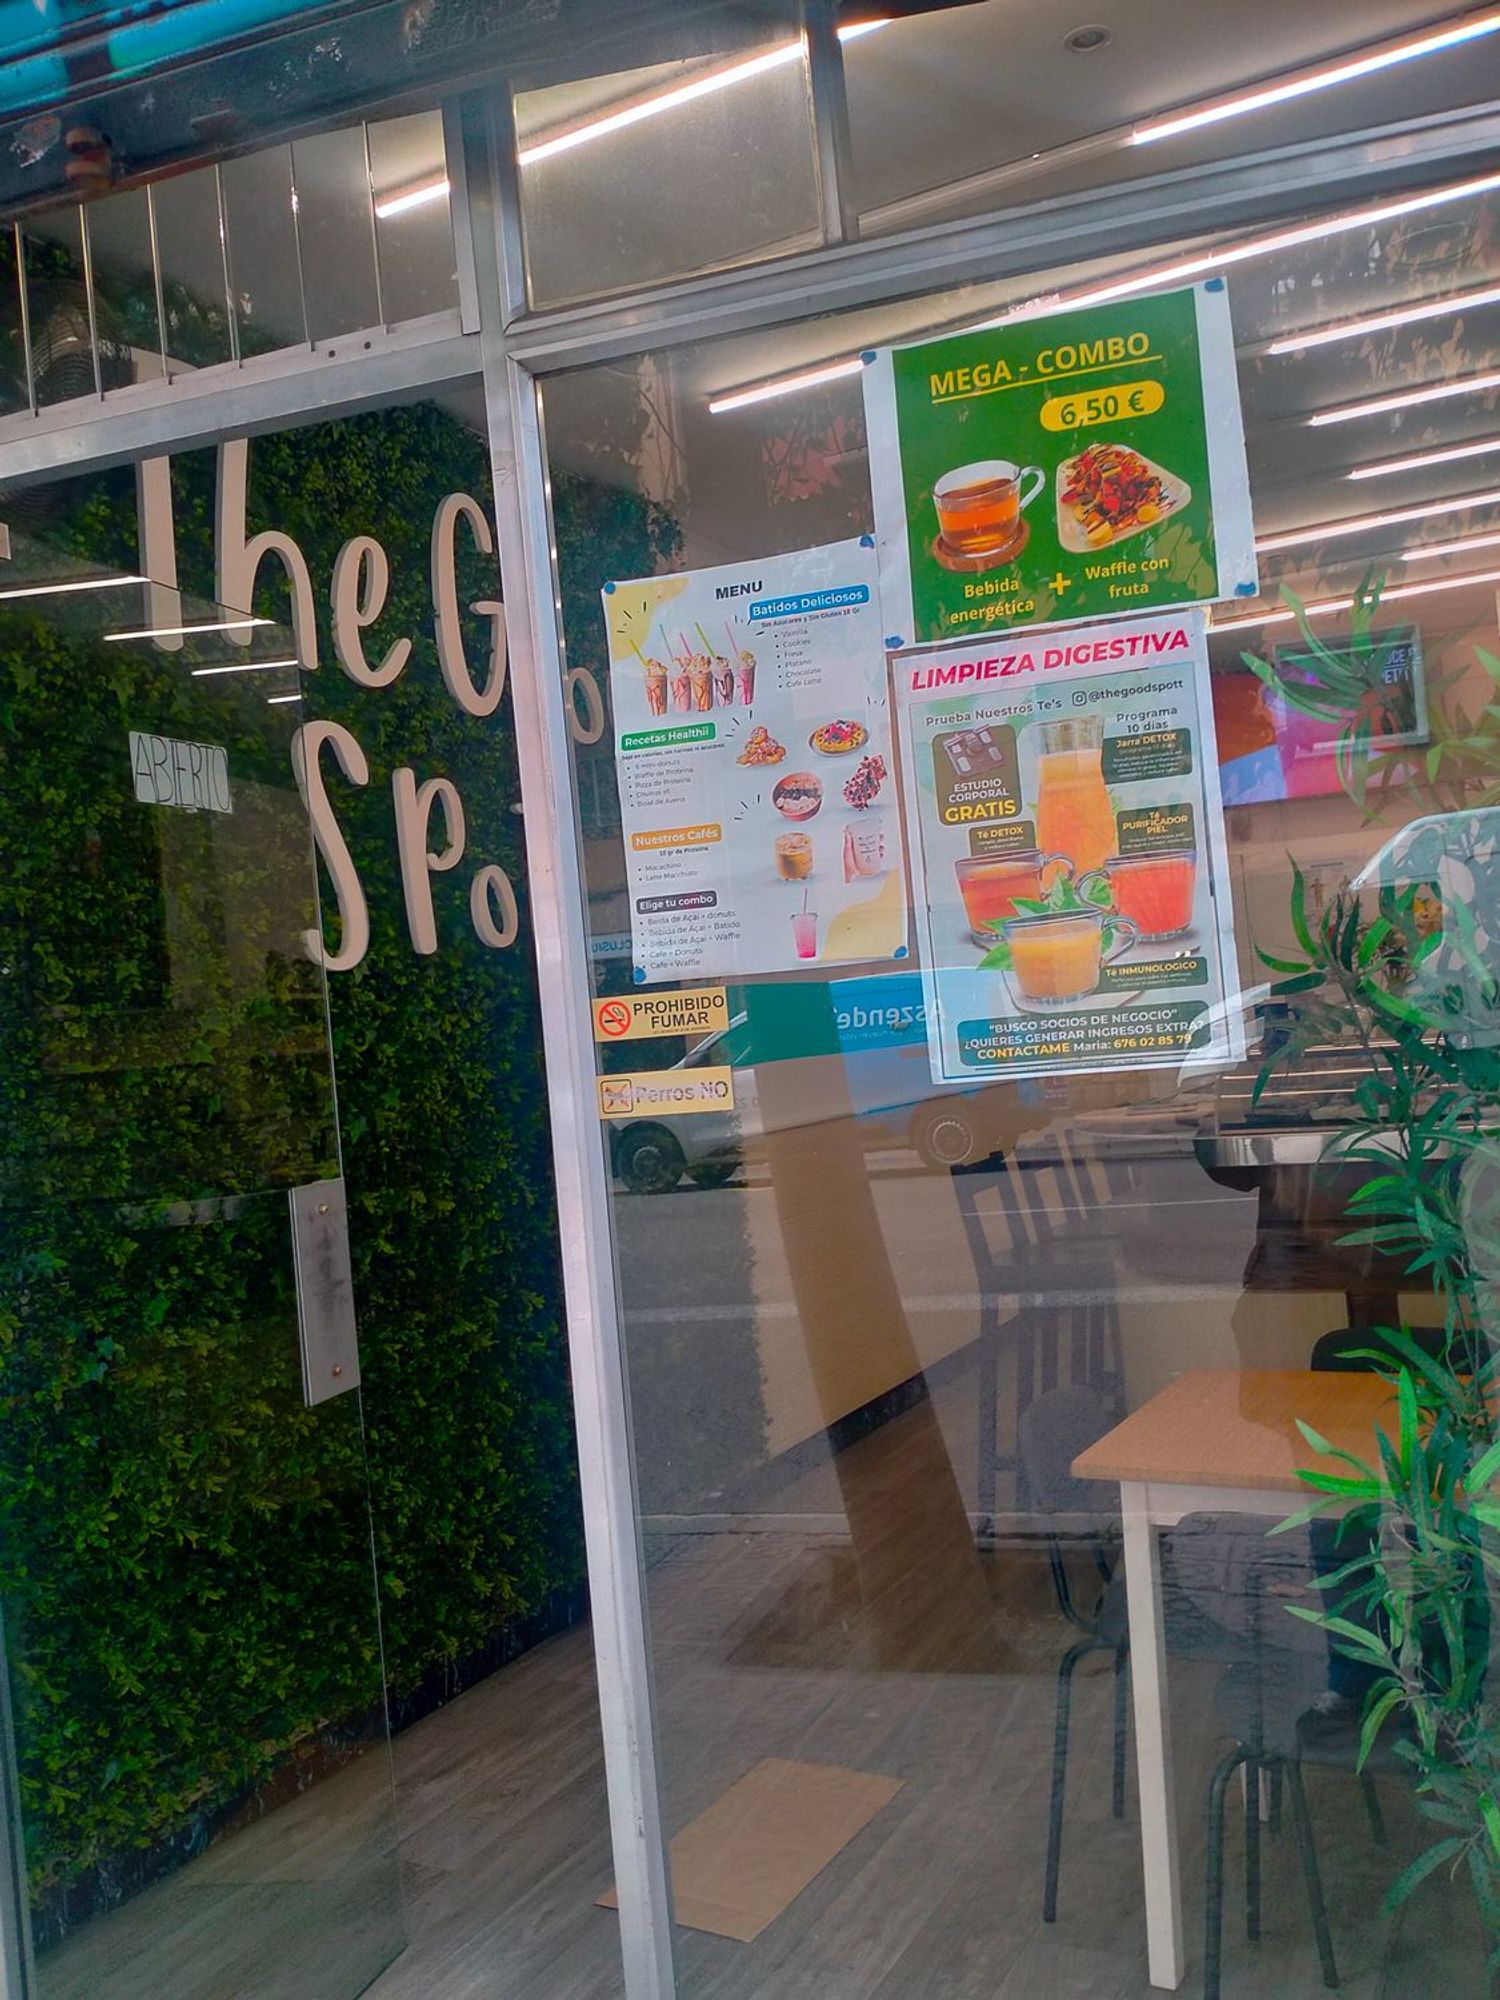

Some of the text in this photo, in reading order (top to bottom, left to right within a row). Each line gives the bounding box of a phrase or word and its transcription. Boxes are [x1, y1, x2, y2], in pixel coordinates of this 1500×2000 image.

[930, 360, 1012, 397] MEGA
[1036, 332, 1149, 375] COMBO
[1061, 390, 1146, 427] 6,50 €
[1085, 556, 1169, 580] Waffle con
[716, 580, 762, 600] MENU
[965, 577, 1020, 598] Bebida
[1108, 581, 1149, 599] fruta
[753, 590, 863, 616] Batidos Deliciosos
[950, 599, 1035, 623] energética
[912, 629, 1189, 690] LIMPIEZA DIGESTIVA
[926, 679, 1184, 727] Prueba Nuestros Te's @thegoodspott
[1116, 707, 1178, 722] Programa
[1127, 723, 1140, 733] 10
[625, 735, 667, 747] Recetas
[1116, 738, 1140, 749] Jarra
[1142, 732, 1177, 745] DETOX
[135, 734, 231, 811] ABIERTO
[948, 787, 1010, 803] CORPORAL
[954, 778, 1002, 793] ESTUDIO
[945, 800, 1016, 821] GRATIS
[990, 826, 1024, 838] DETOX
[1122, 815, 1188, 831] PURIFICADOR
[1146, 825, 1168, 834] PIEL
[635, 833, 686, 846] Nuestros
[640, 894, 713, 912] Elige tu combo
[1119, 961, 1197, 976] INMUNOLOGICO
[633, 995, 724, 1016] PROHIBIDO
[651, 1011, 709, 1029] FUMAR
[1040, 1017, 1087, 1029] SOCIOS
[1090, 1014, 1109, 1025] DE
[965, 1020, 1204, 1049] ¿QUIERES GENERAR INGRESOS EXTRA?
[977, 1042, 1071, 1059] CONTACTAME
[1113, 1038, 1137, 1048] 676
[1140, 1037, 1156, 1047] 02
[1158, 1035, 1174, 1045] 85
[1176, 1033, 1192, 1044] 79
[635, 1080, 729, 1104] Perros NO
